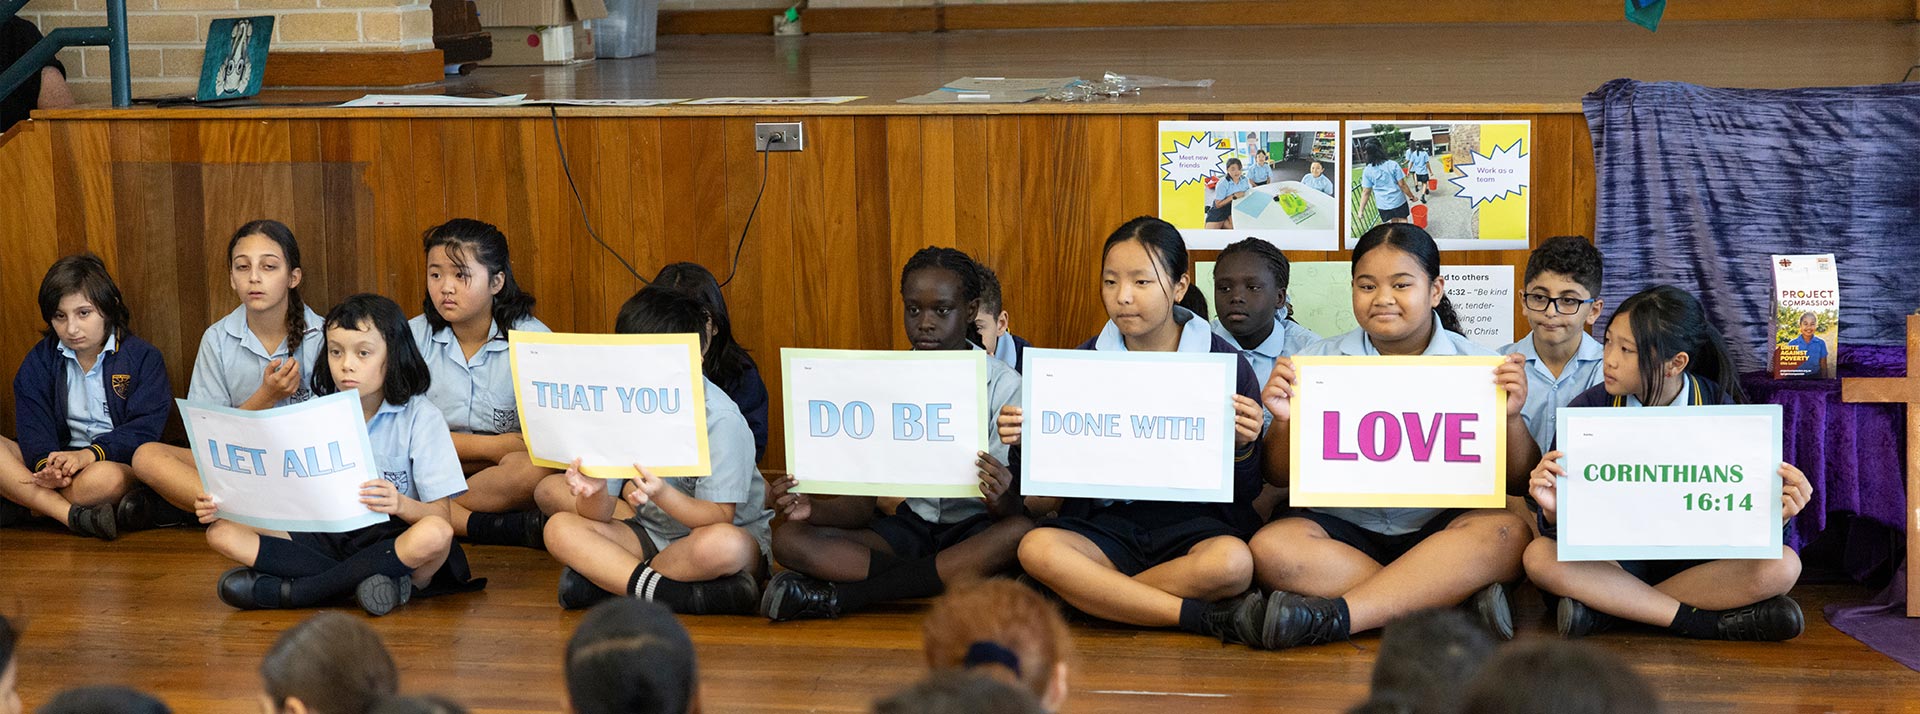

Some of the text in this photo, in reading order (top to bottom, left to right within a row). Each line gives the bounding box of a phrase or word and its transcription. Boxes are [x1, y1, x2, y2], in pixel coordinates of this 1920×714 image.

[1447, 288, 1466, 296] 4:32
[1490, 288, 1508, 296] kind
[1782, 290, 1834, 298] PROJECT
[1465, 302, 1495, 310] tender-
[1459, 315, 1475, 324] ving
[1474, 327, 1499, 335] Christ
[532, 380, 681, 415] THAT YOU
[808, 399, 955, 442] DO BE
[1041, 410, 1206, 441] DONE WITH
[1322, 410, 1482, 464] LOVE
[207, 438, 356, 478] LET ALL
[1583, 463, 1745, 484] CORINTHIANS
[1682, 492, 1754, 512] 16:14
